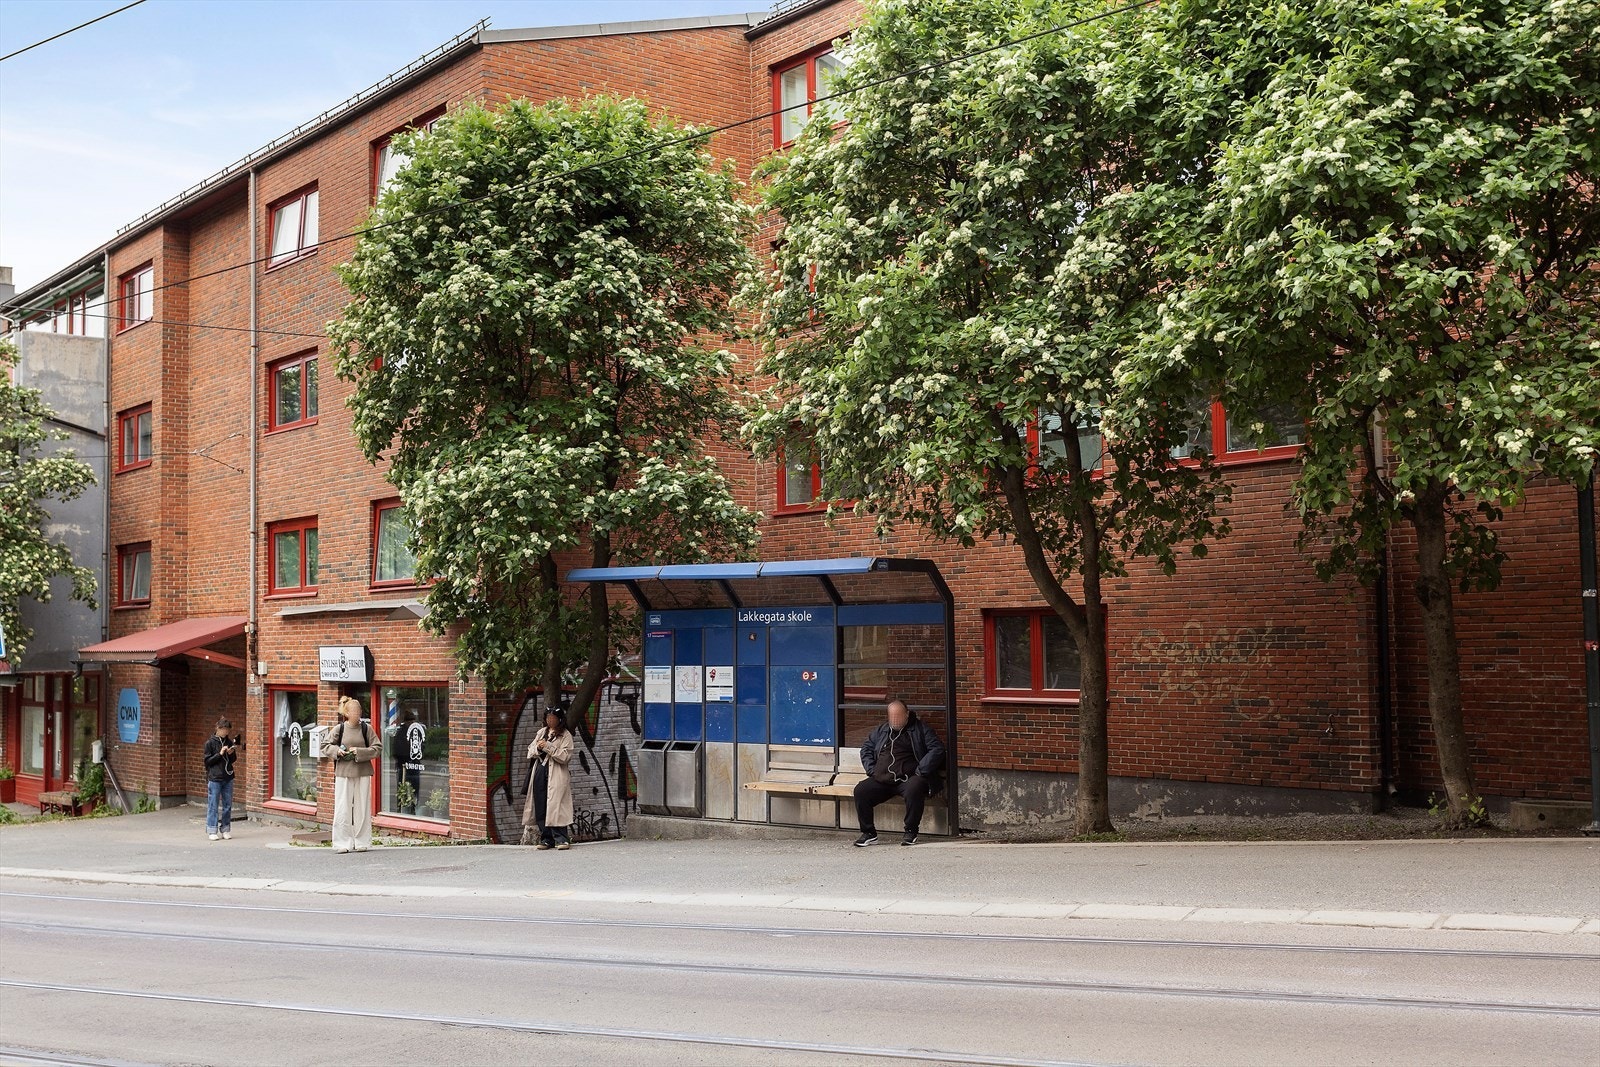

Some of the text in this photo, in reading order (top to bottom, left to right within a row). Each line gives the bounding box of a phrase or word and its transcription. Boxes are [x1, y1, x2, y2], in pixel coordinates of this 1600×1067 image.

[738, 610, 812, 624] Lakkegata skole
[321, 659, 339, 668] STYLISH
[120, 705, 138, 721] CYAN
